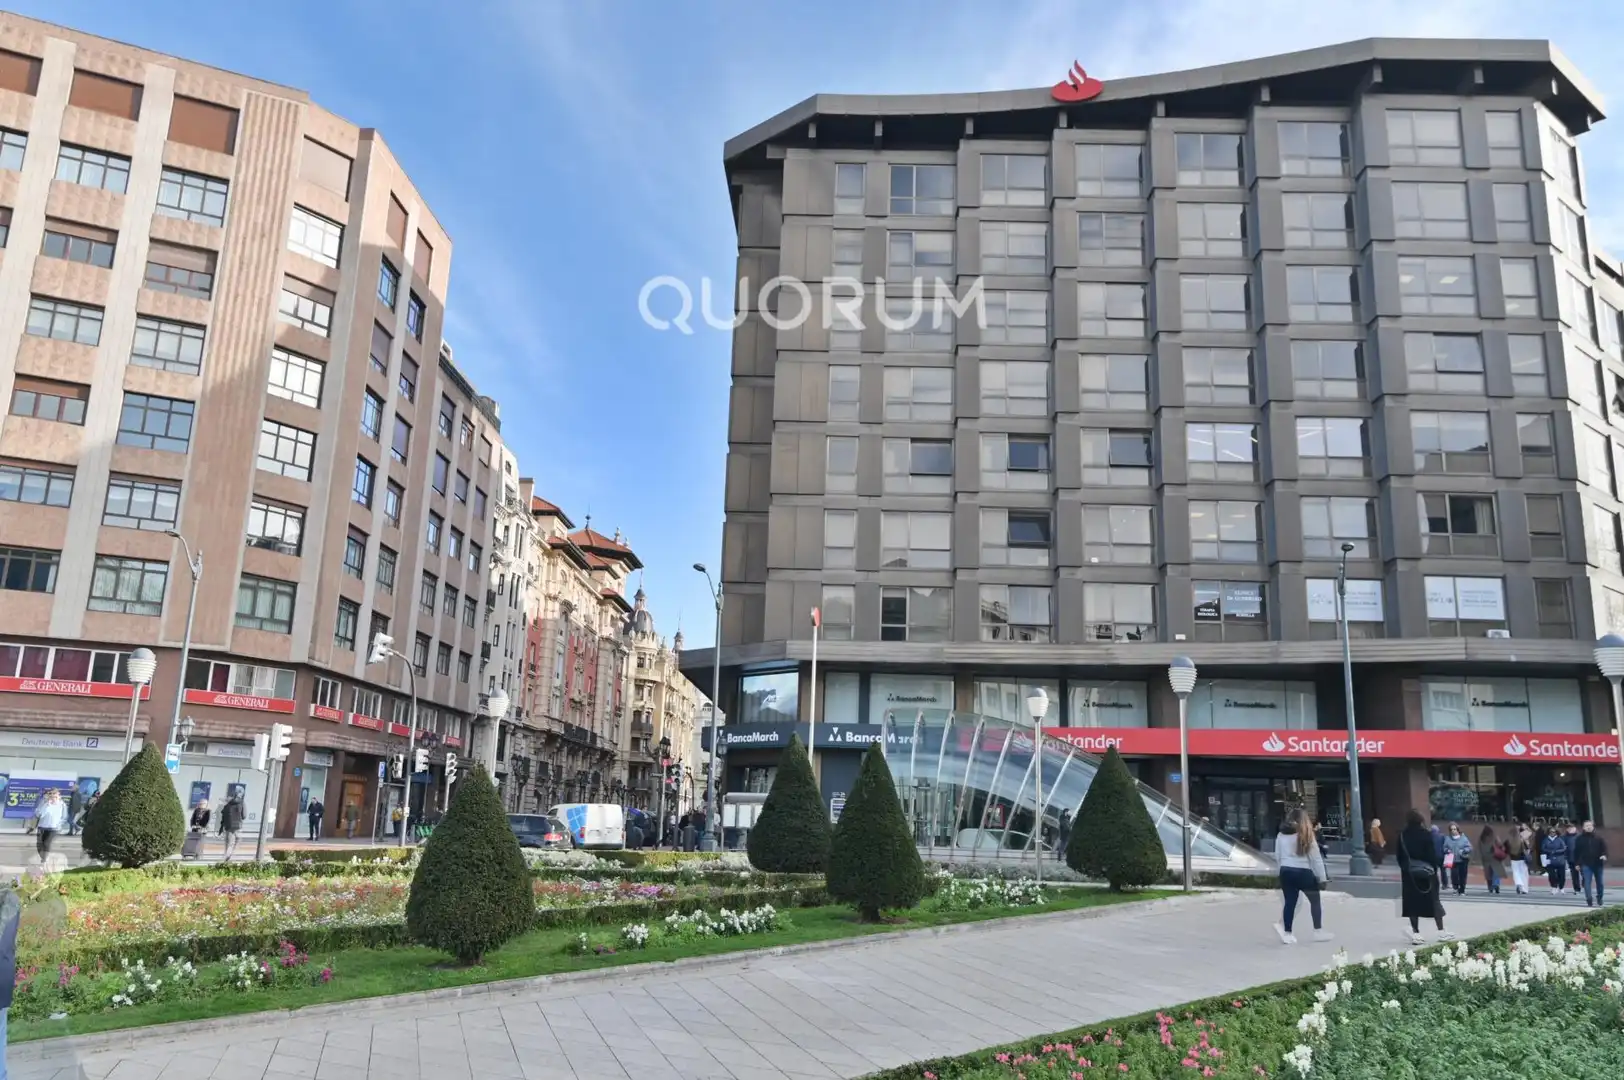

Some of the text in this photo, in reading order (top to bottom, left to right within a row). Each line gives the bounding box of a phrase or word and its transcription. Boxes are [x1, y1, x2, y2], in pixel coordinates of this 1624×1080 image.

[37, 681, 92, 694] GENERALI
[227, 695, 270, 709] GENERALI
[21, 737, 83, 748] Deutsche Bank
[727, 731, 779, 743] BancaMarch
[1529, 739, 1621, 758] Santande
[7, 792, 19, 807] 3
